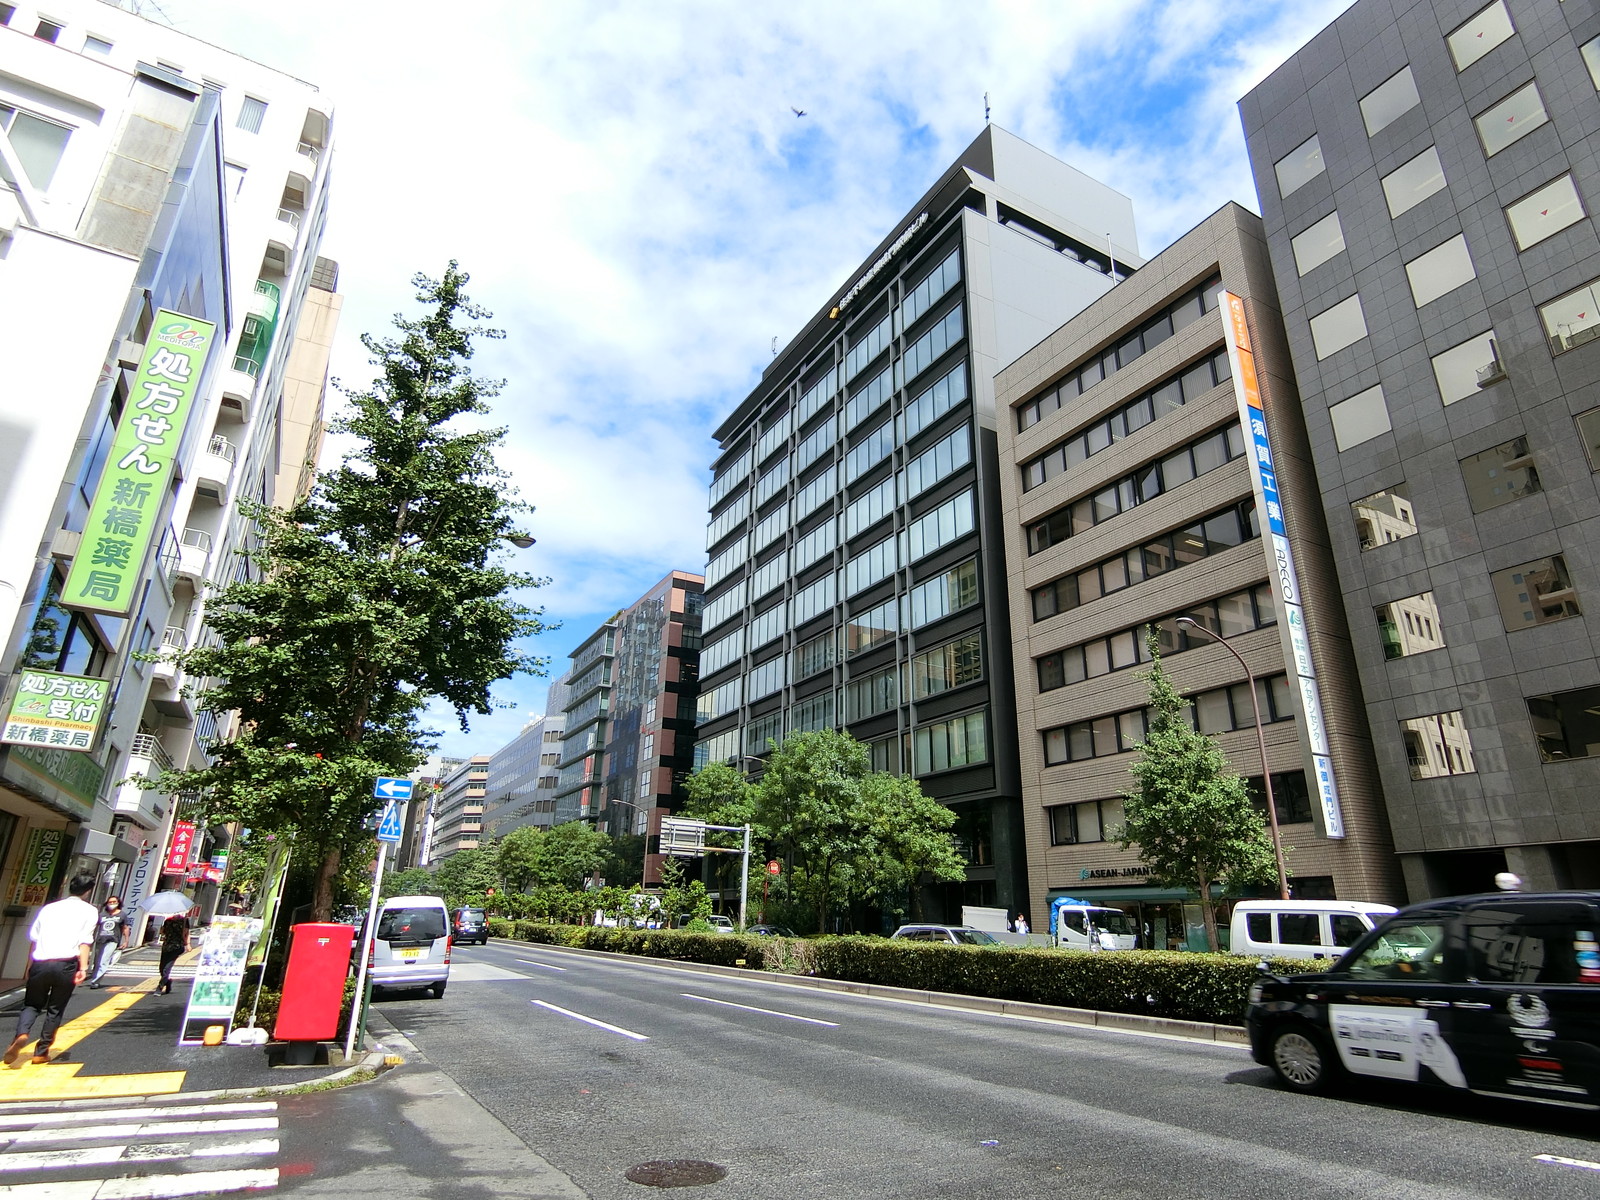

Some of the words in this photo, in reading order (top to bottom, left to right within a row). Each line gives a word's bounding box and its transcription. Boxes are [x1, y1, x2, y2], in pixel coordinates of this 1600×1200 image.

[118, 347, 192, 474] 処方せん
[1252, 418, 1282, 521] 須賀工業
[79, 477, 153, 602] 新橋薬局
[20, 673, 104, 701] 処方せん
[12, 715, 53, 726] Shinbashi
[54, 720, 94, 731] Pharmacy
[46, 699, 98, 722] 受付
[7, 724, 91, 747] 新橋薬局
[31, 830, 60, 884] 処方せん
[1090, 867, 1150, 878] ASEAN-JAPAN
[26, 885, 47, 893] FAX
